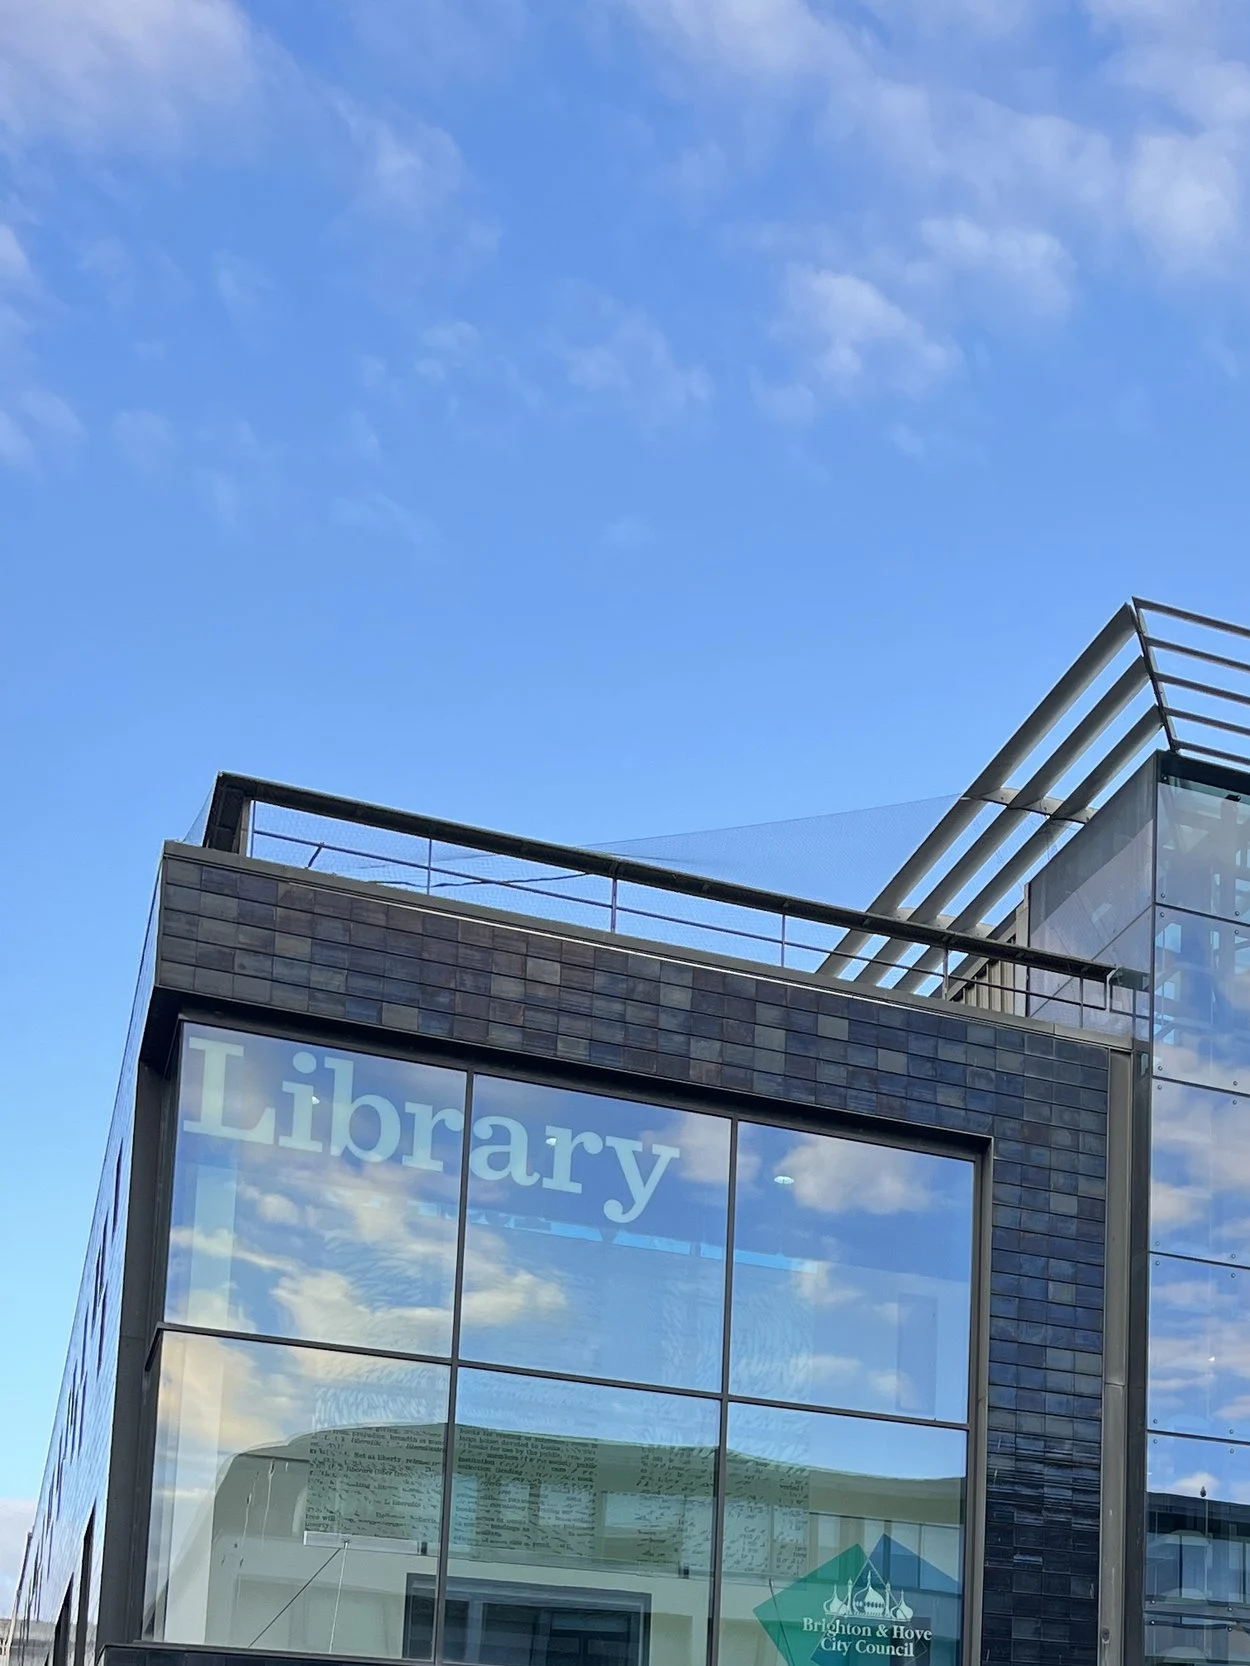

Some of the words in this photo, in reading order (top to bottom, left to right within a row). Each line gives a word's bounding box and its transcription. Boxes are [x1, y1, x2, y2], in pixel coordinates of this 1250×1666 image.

[183, 1036, 680, 1223] Library
[803, 1617, 871, 1637] Brighton
[876, 1624, 888, 1638] &
[892, 1625, 933, 1641] Hove
[821, 1637, 852, 1656] City
[855, 1640, 914, 1657] Council
